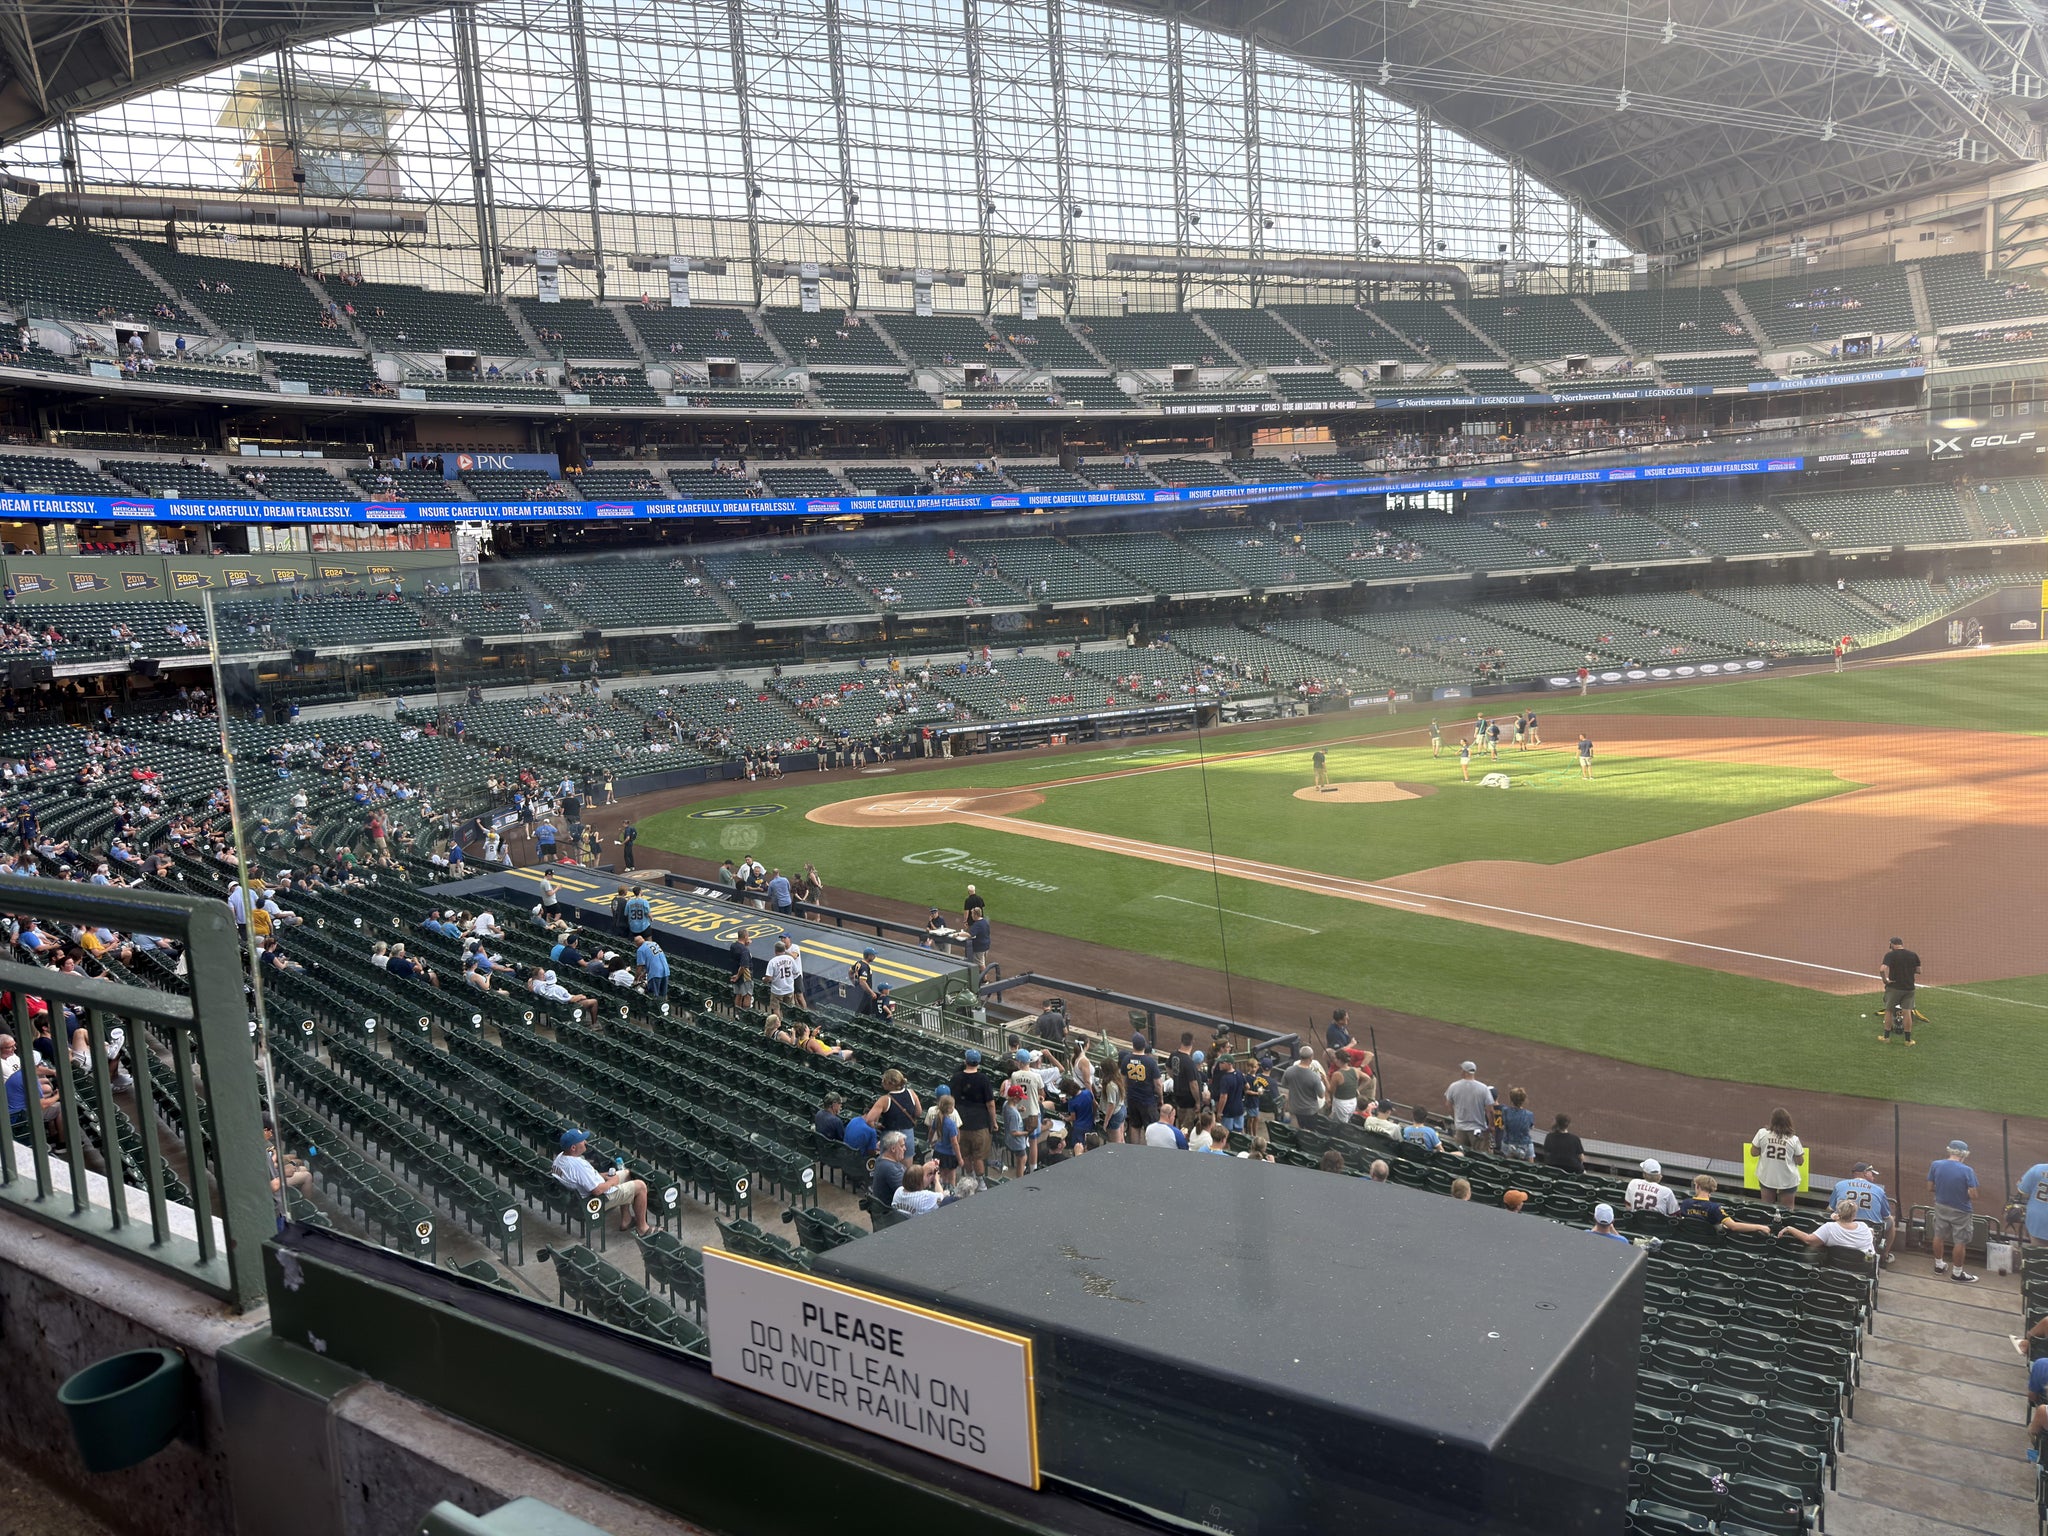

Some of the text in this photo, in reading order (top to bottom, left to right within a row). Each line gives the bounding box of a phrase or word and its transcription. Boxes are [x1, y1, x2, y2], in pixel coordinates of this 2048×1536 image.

[225, 234, 237, 242] 425
[1830, 375, 1860, 384] TEQUILA
[1561, 387, 1694, 402] Northwestern Mutual LEGENDS CLUB
[1406, 398, 1451, 406] Northwestern
[1452, 397, 1475, 405] Mutual
[1481, 396, 1508, 404] LEGENDS
[1225, 404, 1236, 412] TEXT
[1237, 403, 1259, 412] "CREW"
[1932, 432, 2036, 453] X GOLF
[1851, 451, 1871, 459] TITO'S
[1877, 448, 1909, 457] AMERICAN
[476, 455, 515, 469] PNC
[1644, 468, 1666, 476] INSURE
[1667, 466, 1700, 475] CAREFULLY,
[1701, 465, 1722, 473] DREAM
[1722, 463, 1760, 472] FEARLESSLY.
[1515, 475, 1545, 483] CAREFULLY,
[1545, 474, 1564, 482] DREAM
[1564, 472, 1600, 481] FEARLESSLY.
[1421, 480, 1455, 488] FEARLESSLY.
[1029, 496, 1052, 504] INSURE
[1053, 495, 1087, 504] CAREFULLY,
[1088, 494, 1110, 502] DREAM
[1111, 492, 1145, 502] FEARLESSLY.
[1189, 490, 1210, 499] INSURE
[33, 500, 98, 514] FEARLESSLY.
[646, 502, 797, 514] INSURE CAREFULLY, DREAM FEARLESSLY.
[850, 501, 876, 509] INSURE
[877, 499, 916, 509] CAREFULLY,
[917, 498, 940, 507] DREAM
[941, 497, 981, 507] FEARLESSLY.
[170, 504, 352, 518] INSURE CAREFULLY, DREAM FEARLESSLY.
[419, 506, 583, 518] INSURE CAREFULLY, DREAM FEARLESSLY.
[74, 574, 93, 582] 2018
[177, 574, 197, 582] 2020
[229, 571, 247, 579] 2021
[277, 570, 294, 578] 2023
[324, 569, 343, 577] 2024
[18, 575, 38, 583] 2011
[965, 858, 997, 867] uw
[942, 861, 1060, 893] credit union
[631, 909, 644, 920] 39
[779, 966, 791, 979] 15
[1127, 1063, 1146, 1082] 29
[1768, 1138, 1787, 1146] YELICH
[1766, 1145, 1787, 1161] 22
[1637, 1183, 1659, 1194] YELICH
[1848, 1181, 1872, 1189] YELICH
[1634, 1192, 1658, 1210] 22
[801, 1301, 905, 1357] PLEASE
[750, 1319, 970, 1416] DO NOT LEAN ON
[741, 1346, 987, 1455] OR OVER RAILINGS
